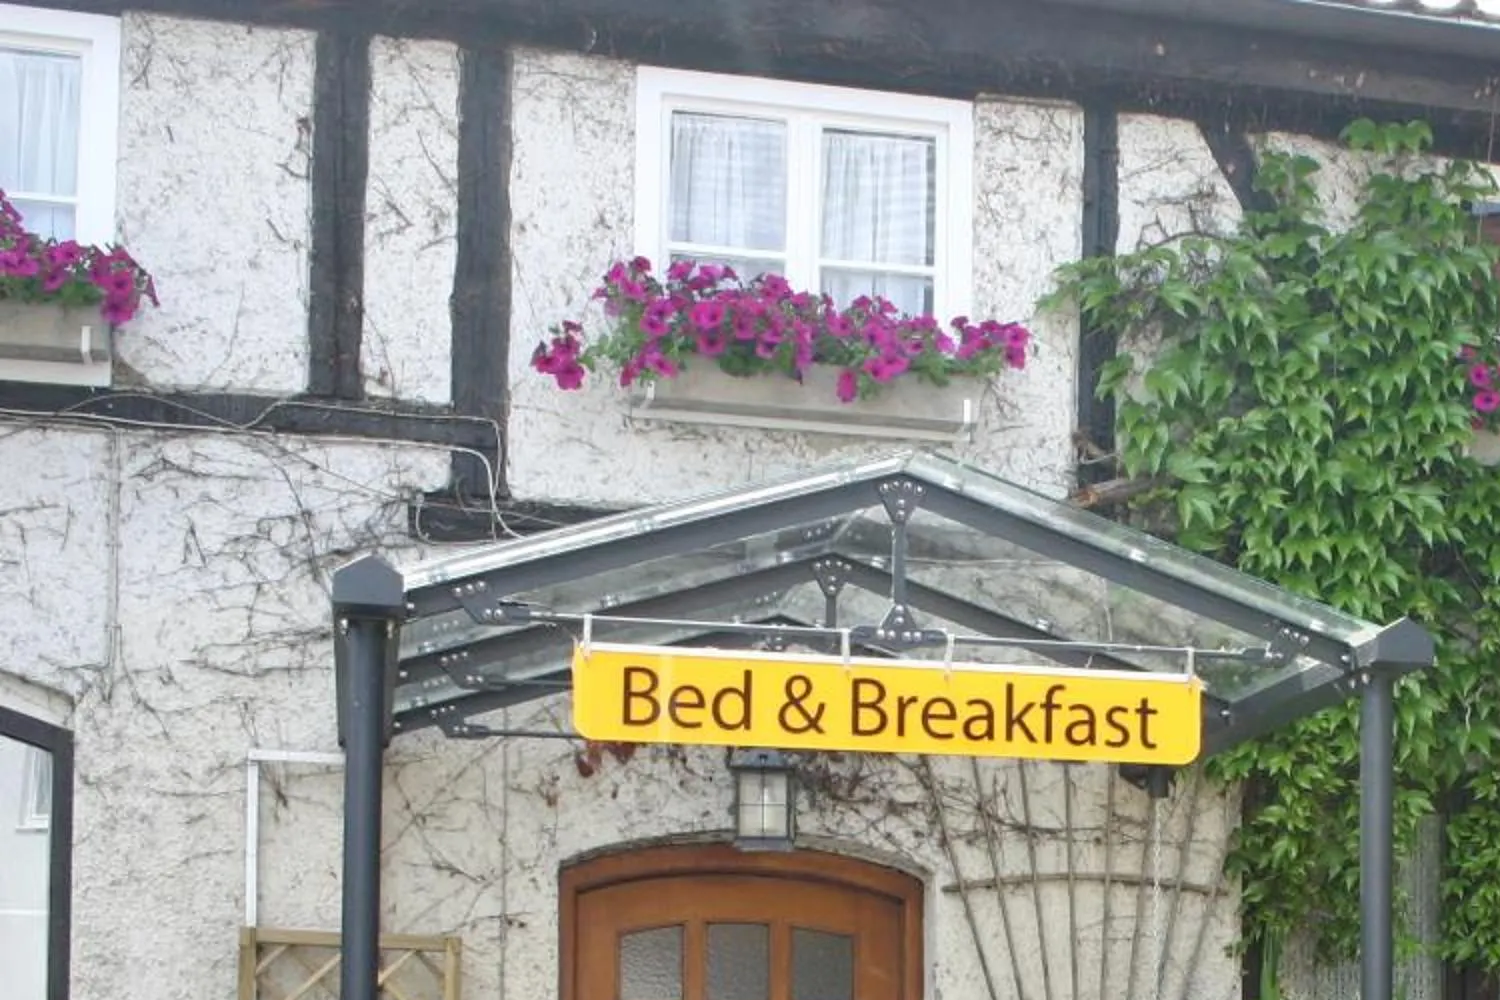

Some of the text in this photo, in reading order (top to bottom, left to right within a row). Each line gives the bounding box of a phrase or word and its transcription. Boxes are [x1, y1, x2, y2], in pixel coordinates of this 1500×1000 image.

[622, 666, 1158, 750] Bed & Breakfast
